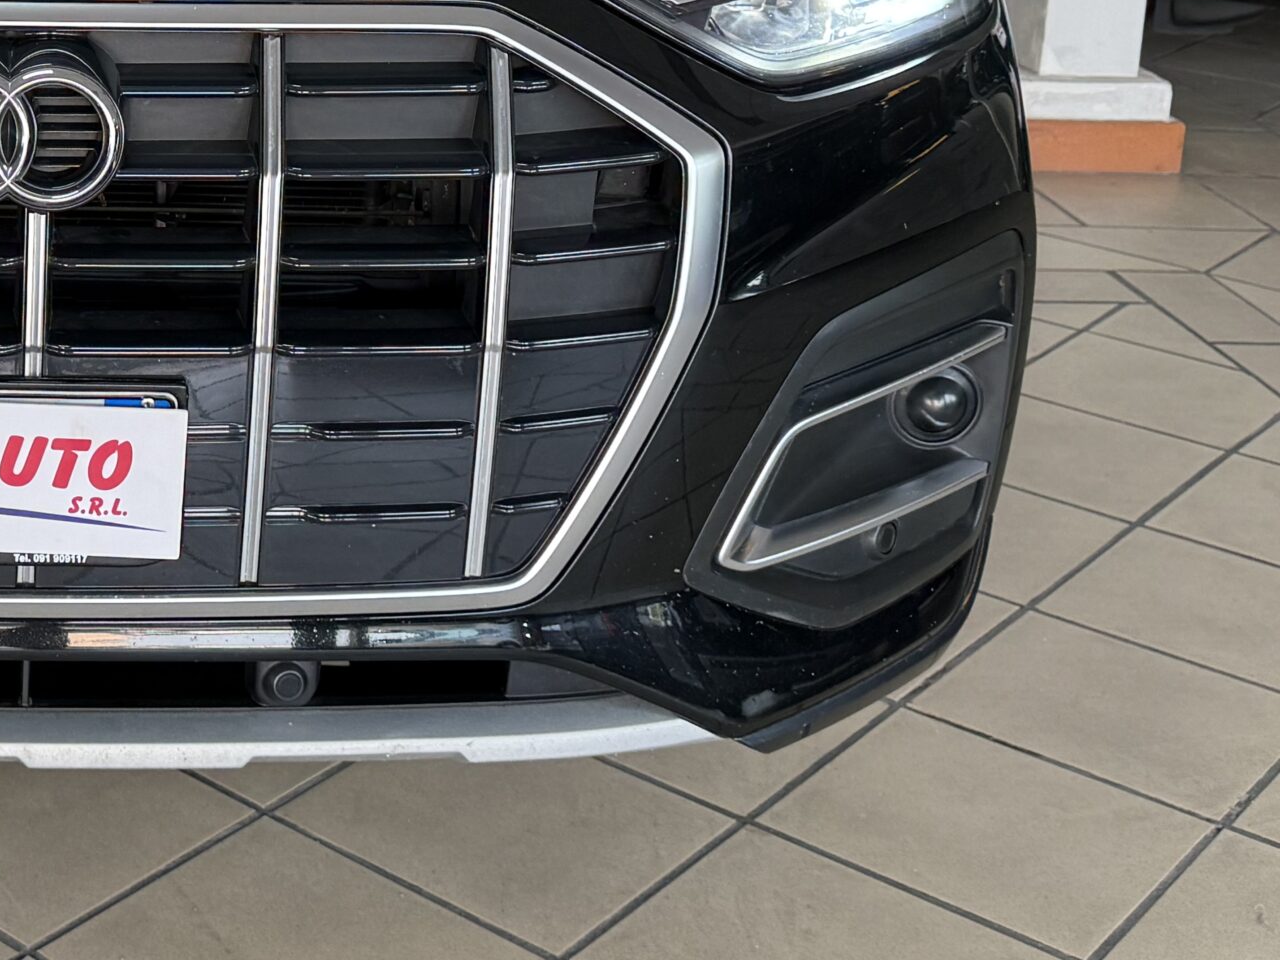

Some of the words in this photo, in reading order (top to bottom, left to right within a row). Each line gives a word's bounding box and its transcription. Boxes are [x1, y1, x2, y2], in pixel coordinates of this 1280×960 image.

[68, 496, 128, 516] S.R.L.
[13, 553, 31, 563] Tel.
[33, 554, 50, 563] 091
[53, 554, 87, 564] 909117
